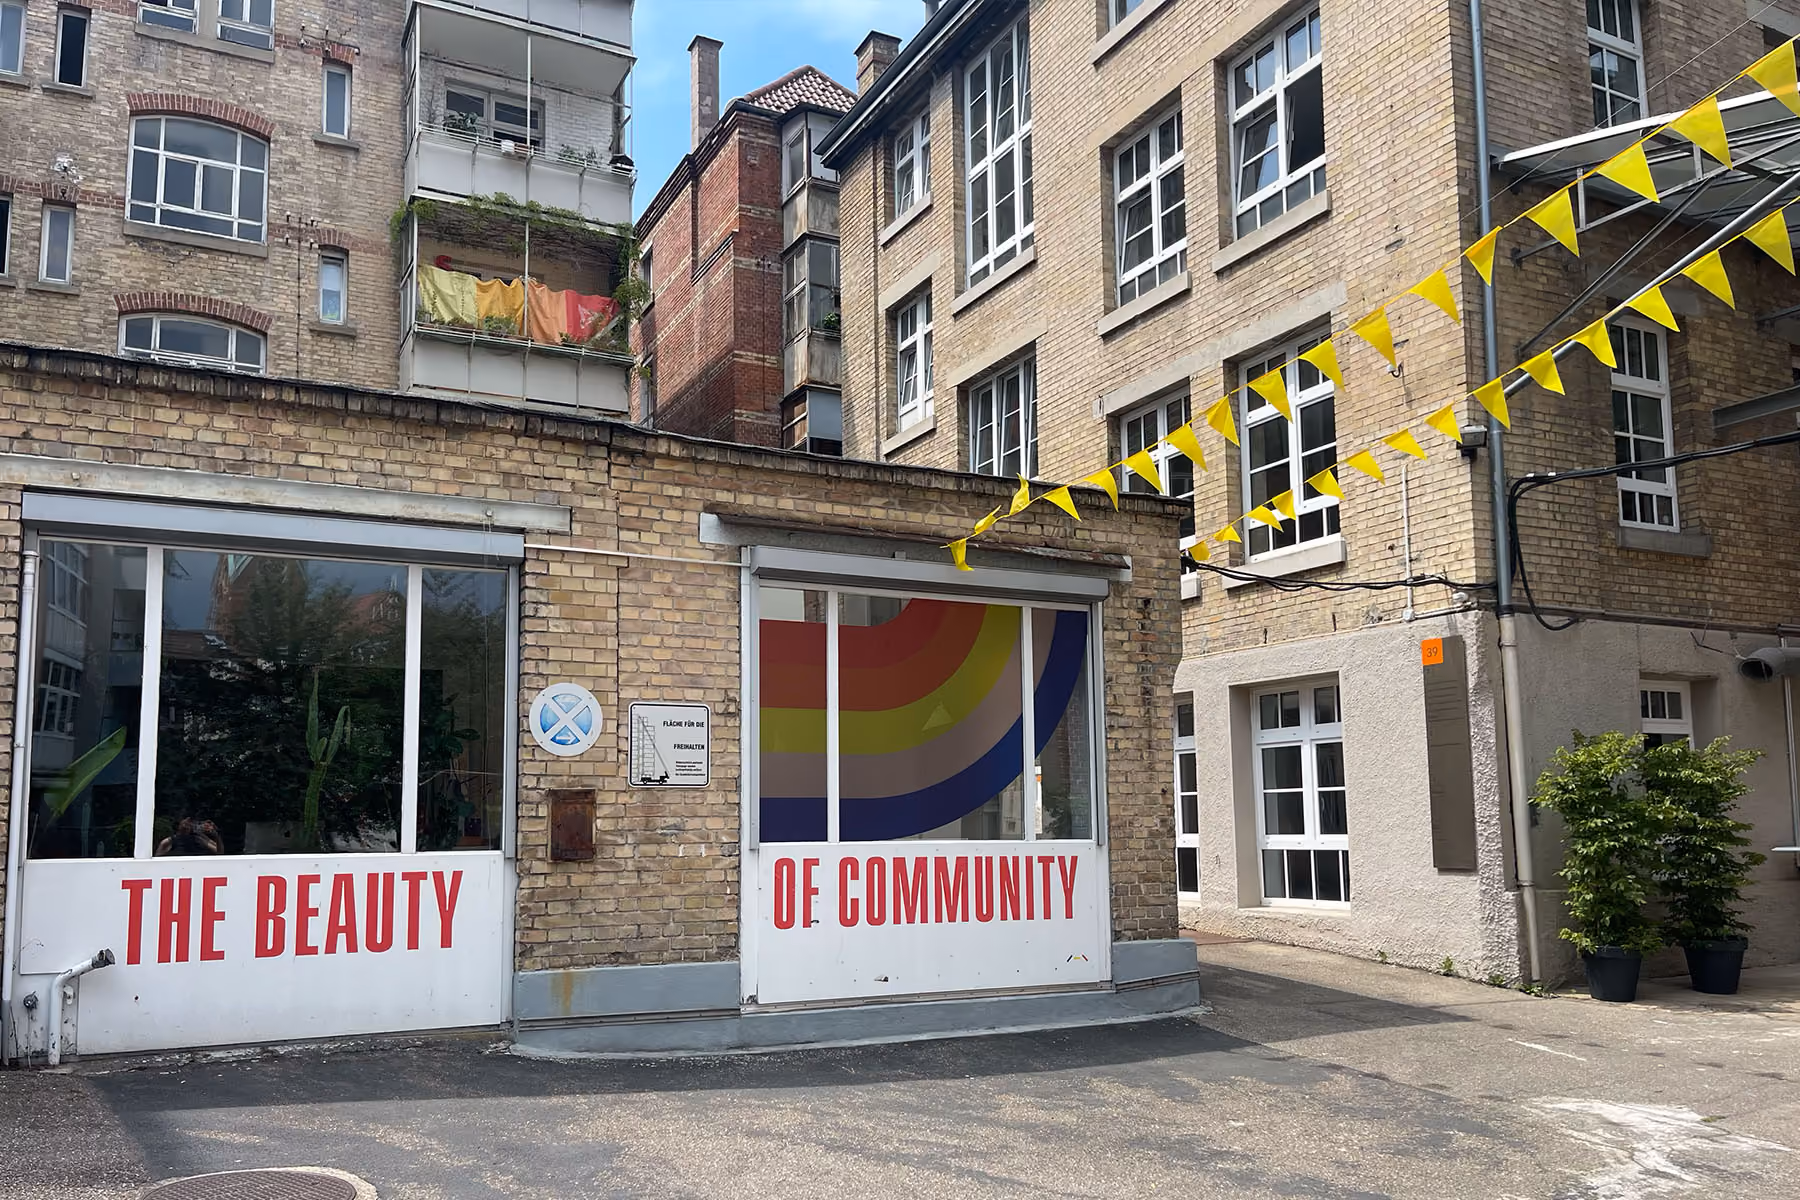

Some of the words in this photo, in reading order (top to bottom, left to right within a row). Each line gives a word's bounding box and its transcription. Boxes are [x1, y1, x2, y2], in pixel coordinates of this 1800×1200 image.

[1427, 646, 1438, 657] 39
[663, 719, 683, 727] FLÄCHE
[774, 857, 820, 930] OF
[838, 855, 1078, 927] COMMUNITY
[121, 876, 228, 964] THE
[255, 870, 463, 958] BEAUTY
